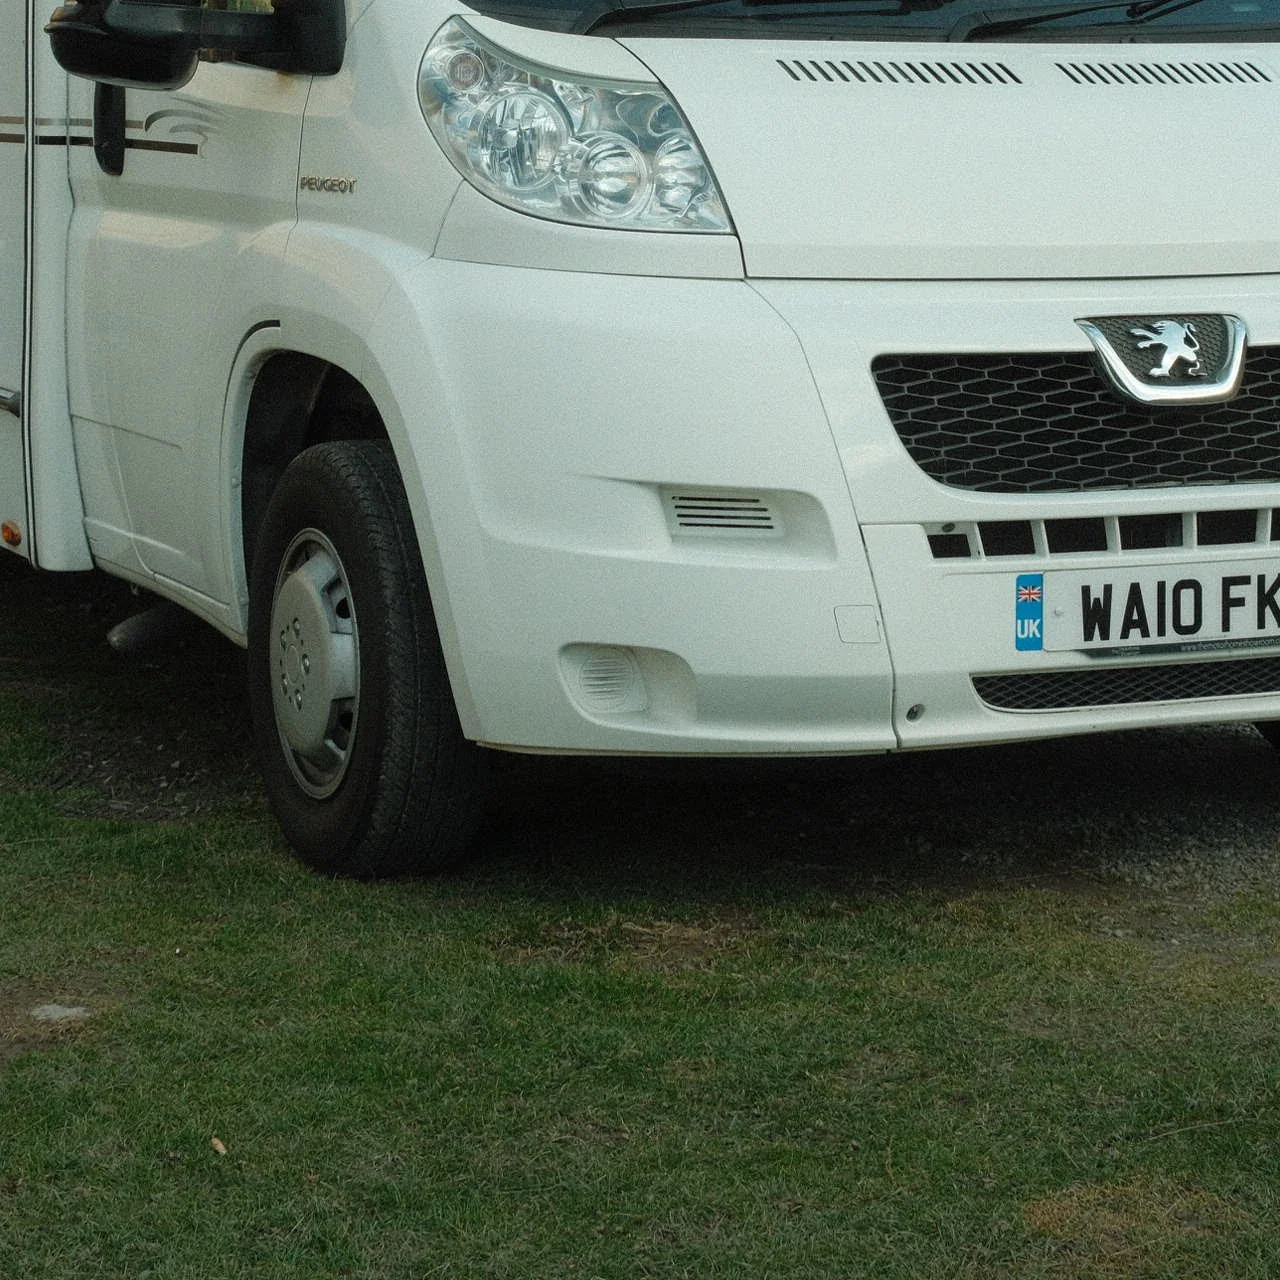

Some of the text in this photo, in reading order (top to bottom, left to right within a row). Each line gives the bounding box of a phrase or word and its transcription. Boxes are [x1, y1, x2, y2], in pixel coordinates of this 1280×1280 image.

[300, 177, 356, 193] PEUGEOT
[1081, 579, 1203, 641] WA10
[1017, 619, 1041, 638] UK
